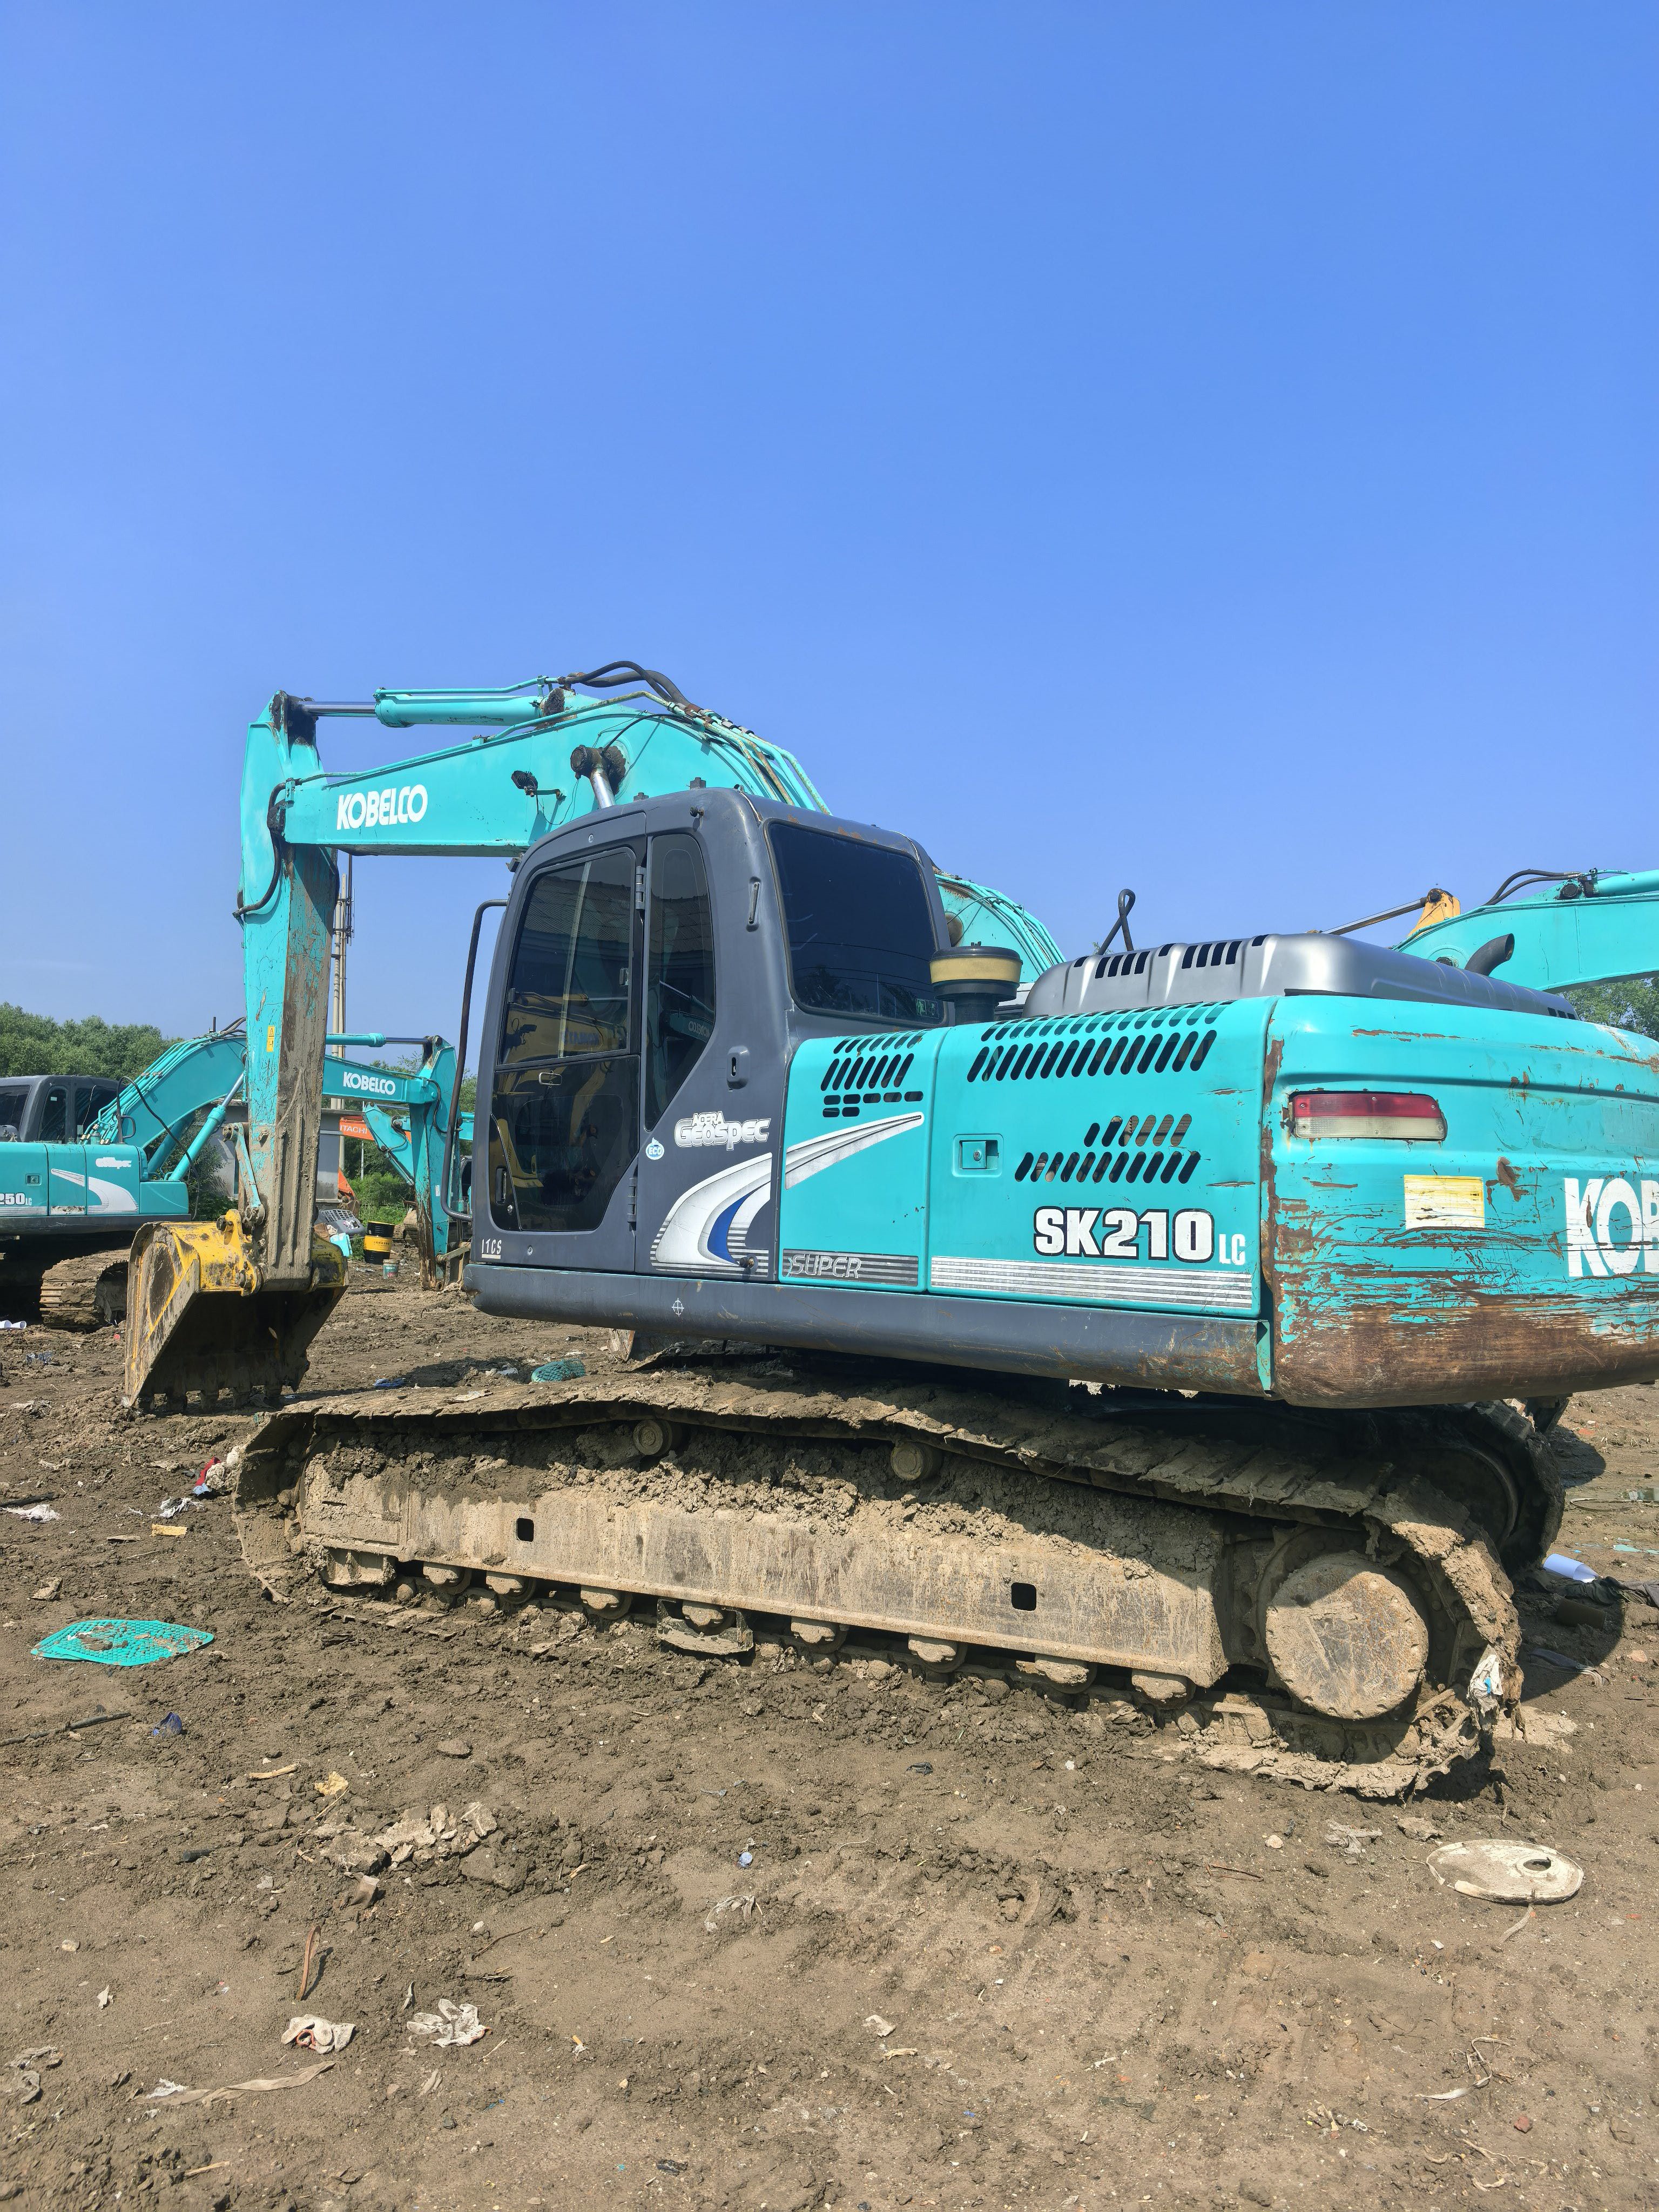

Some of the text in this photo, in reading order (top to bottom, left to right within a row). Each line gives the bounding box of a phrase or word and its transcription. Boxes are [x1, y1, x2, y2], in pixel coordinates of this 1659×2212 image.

[337, 784, 428, 831] KOBELCO
[343, 1071, 396, 1095] KOBELCO
[339, 1124, 368, 1134] ITACHI
[648, 1146, 663, 1155] ECO
[482, 1238, 502, 1255] ITCS
[1033, 1205, 1246, 1265] SK210 LC
[790, 1253, 862, 1279] SUPER
